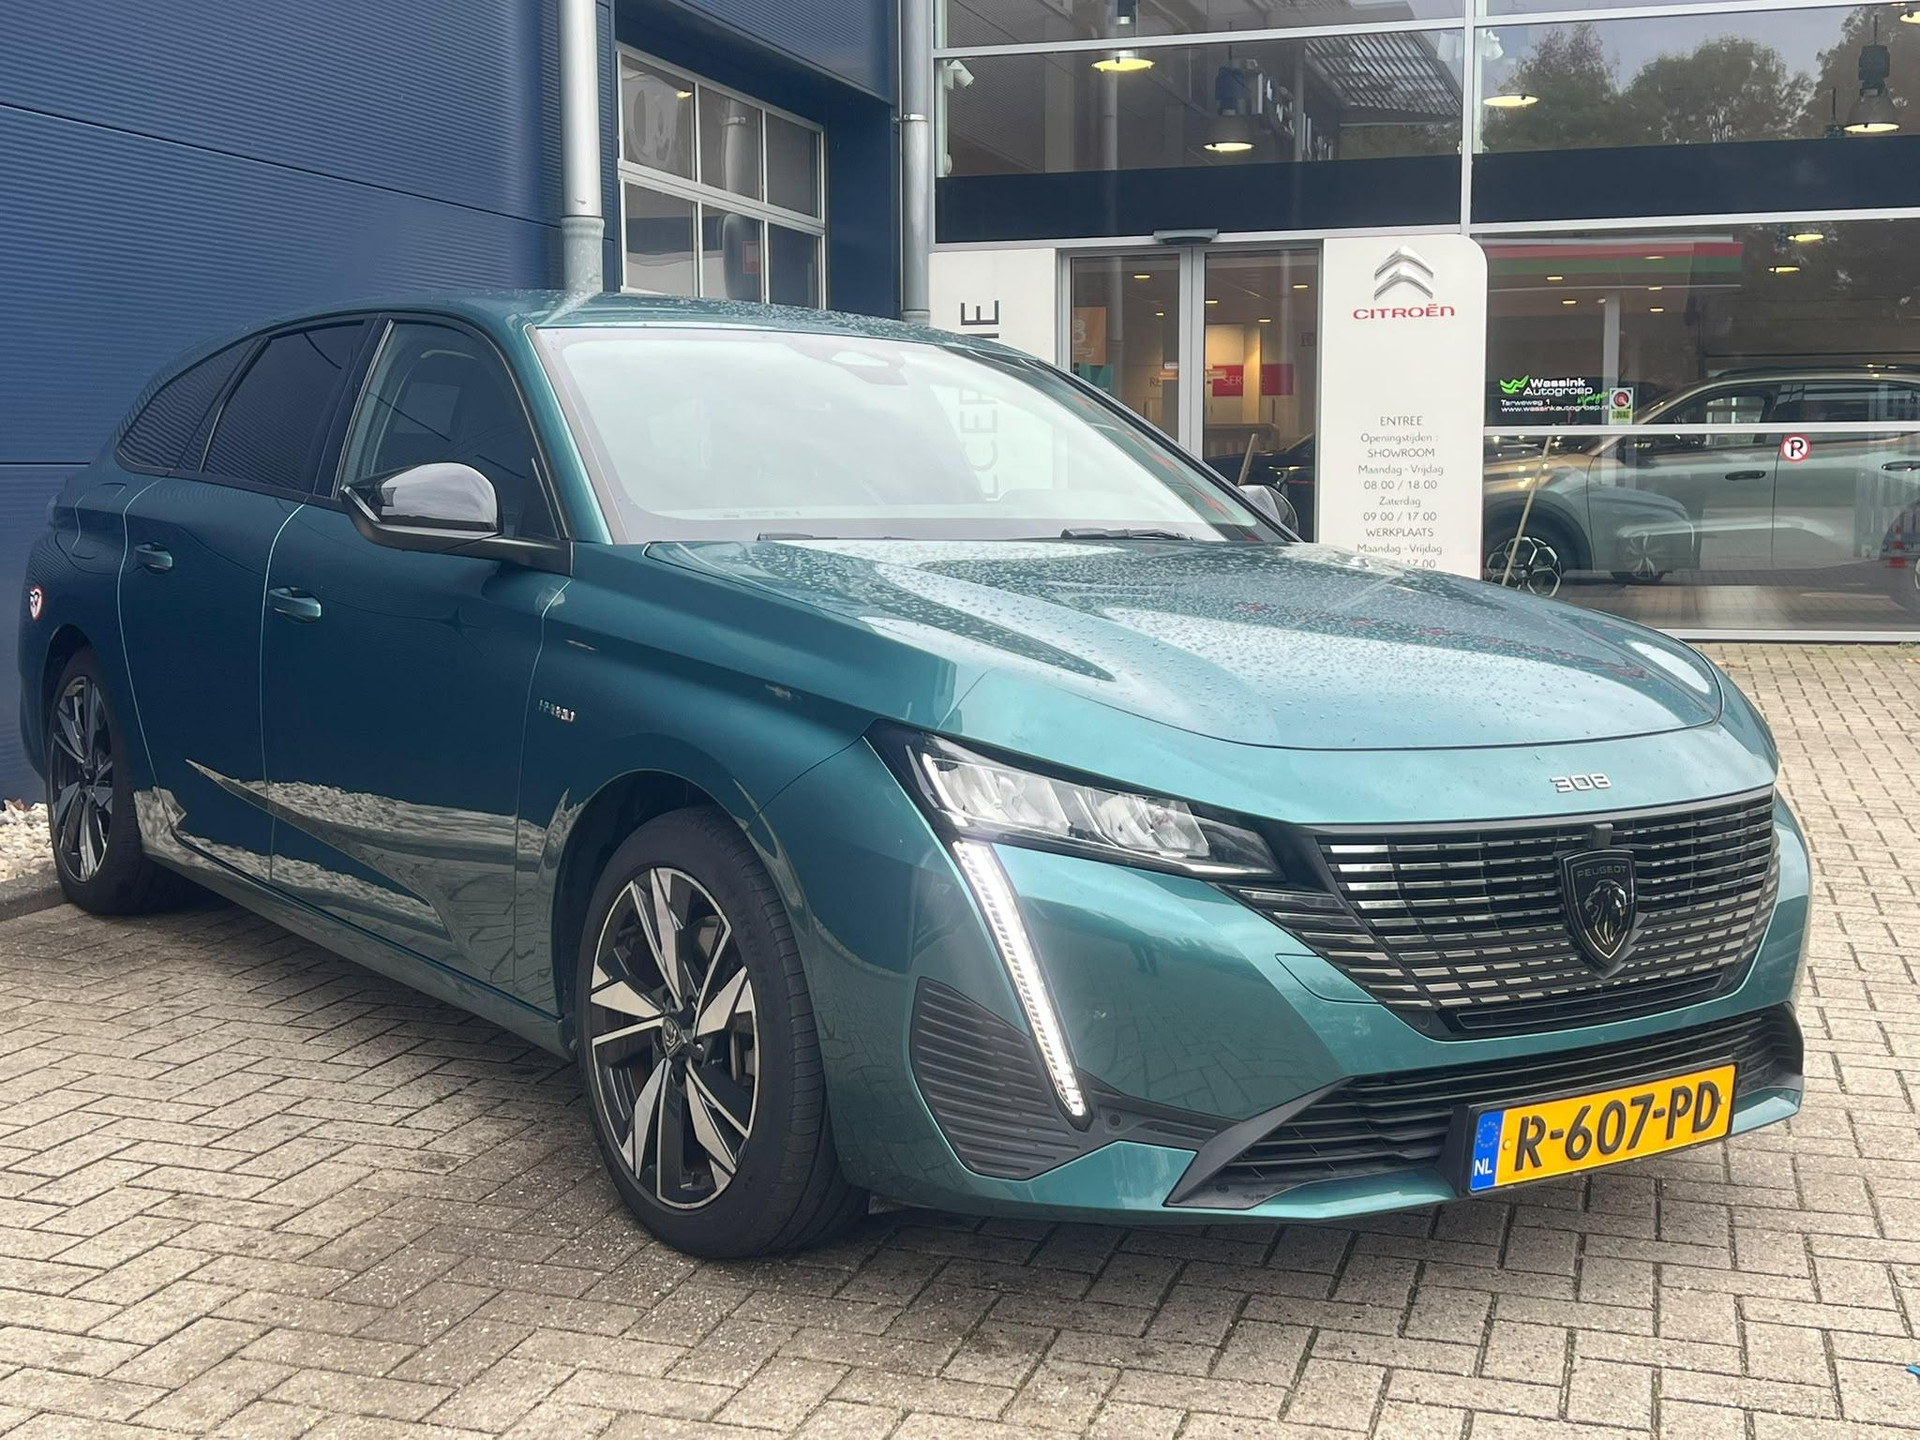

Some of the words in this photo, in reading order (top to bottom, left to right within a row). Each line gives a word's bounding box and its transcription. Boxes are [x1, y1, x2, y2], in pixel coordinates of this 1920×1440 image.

[1530, 377, 1586, 388] Wassink
[1523, 387, 1594, 397] Autogroep
[1380, 415, 1423, 427] ENTREE
[1360, 432, 1433, 444] Openingstijden
[1367, 448, 1435, 458] SHOWROOM
[1358, 464, 1402, 476] Maandag
[1410, 464, 1444, 476] Vrijdag
[1379, 496, 1421, 507] Zaterdag
[1365, 527, 1434, 537] WERKPLAATS
[1356, 543, 1401, 556] Maandag
[1409, 543, 1443, 556] Vrijdag
[1550, 773, 1612, 793] 308
[1576, 865, 1628, 878] PEUGEOT
[1473, 1158, 1493, 1176] NL
[1514, 1080, 1720, 1172] R-607-PD
